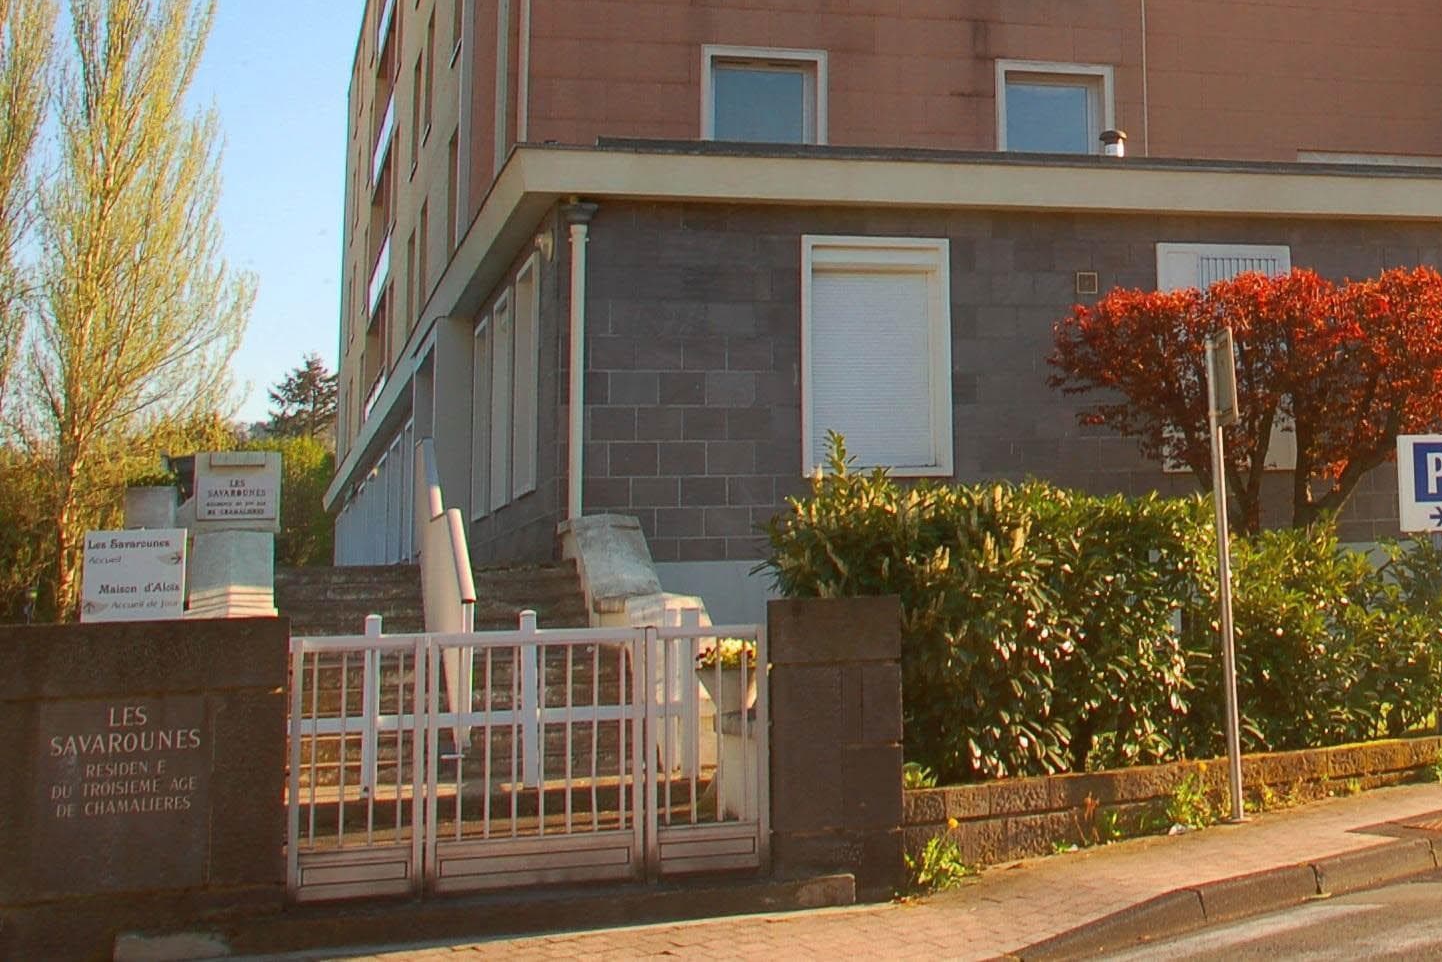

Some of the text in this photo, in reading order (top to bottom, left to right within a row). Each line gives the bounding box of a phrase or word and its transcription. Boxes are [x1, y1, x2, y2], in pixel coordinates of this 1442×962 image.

[230, 479, 245, 487] LES
[88, 538, 170, 550] Les Savarounes
[99, 583, 137, 594] Maison
[110, 706, 148, 727] LES
[50, 729, 201, 757] SAVAROUNES
[86, 760, 166, 778] RESIDENE
[51, 776, 197, 799] DU TROISIEME AGE
[56, 795, 192, 818] DE CHAMALIERES
